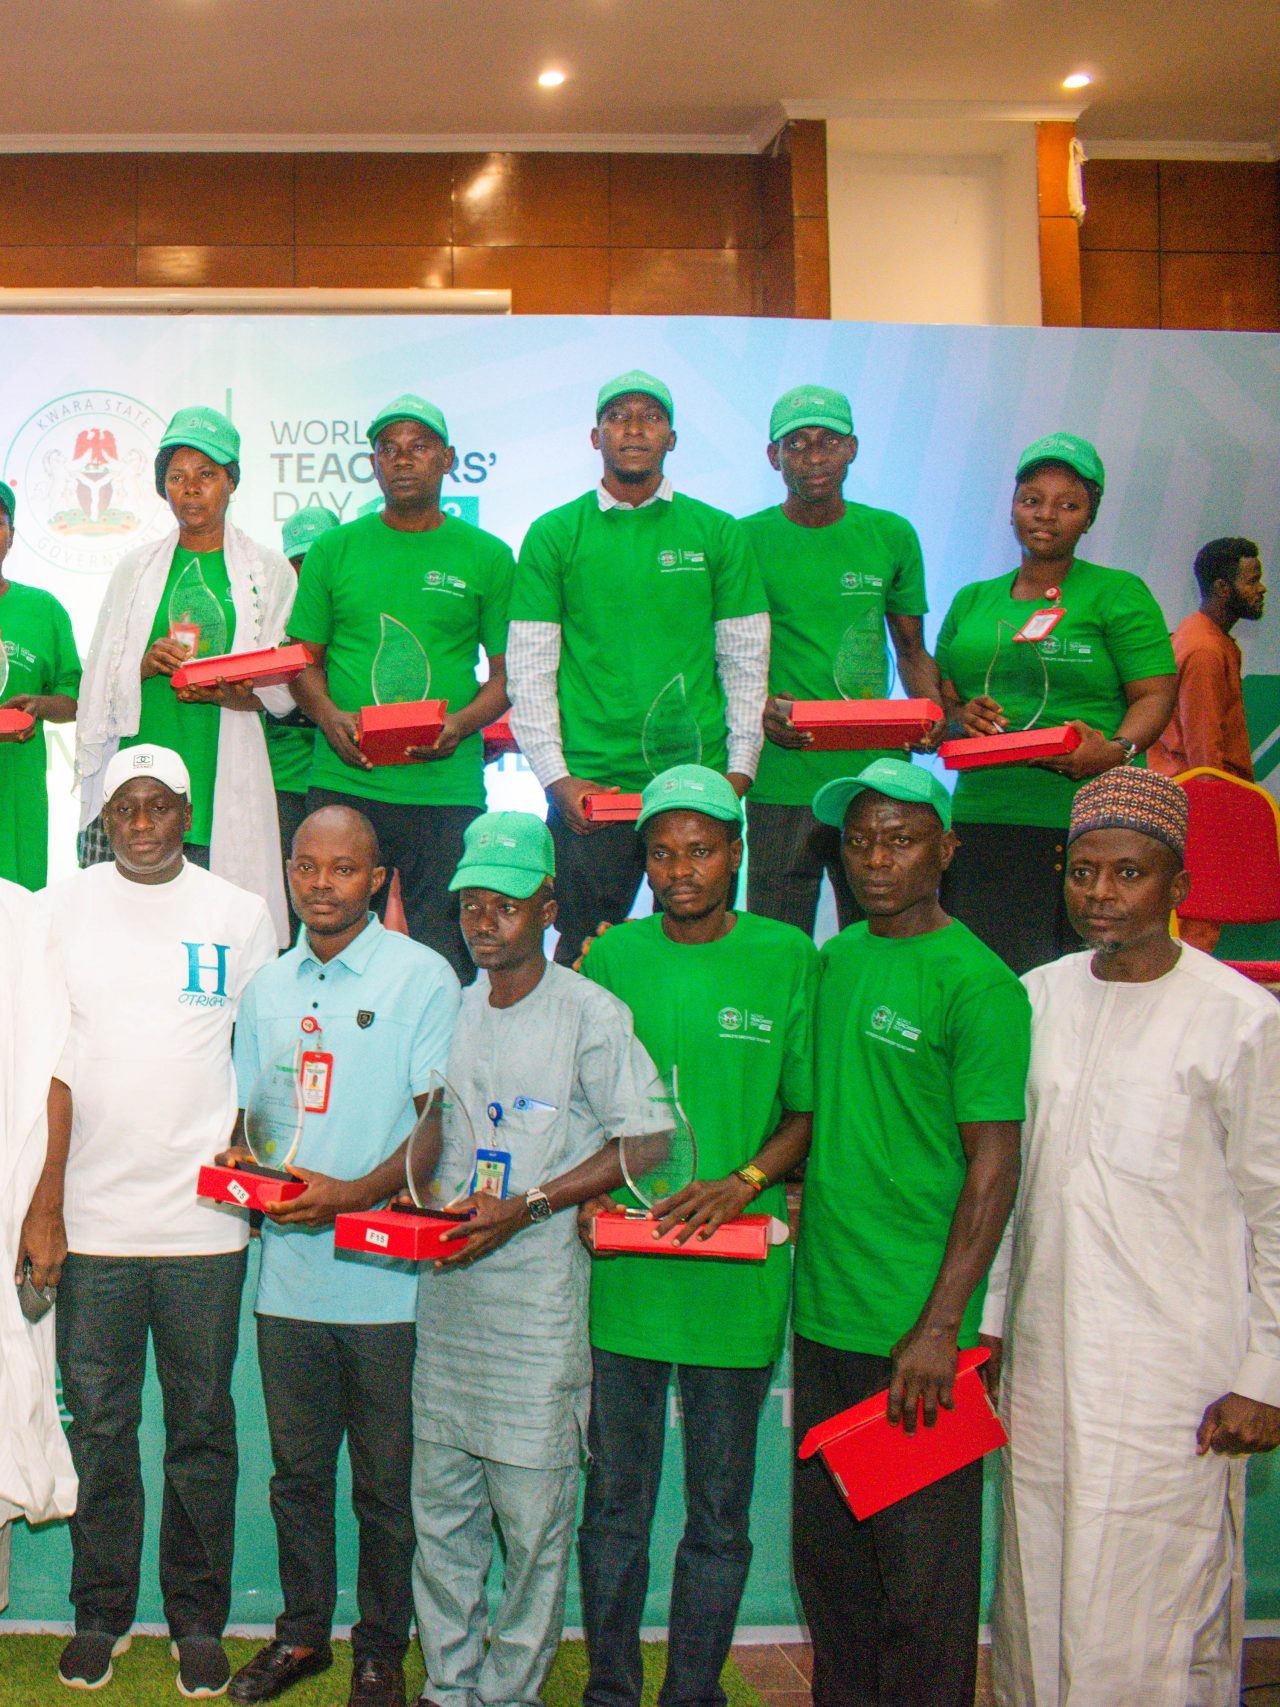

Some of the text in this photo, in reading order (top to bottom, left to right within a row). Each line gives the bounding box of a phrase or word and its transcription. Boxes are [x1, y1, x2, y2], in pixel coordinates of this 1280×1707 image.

[36, 399, 152, 431] KWARA STATE
[270, 420, 374, 445] WORL
[181, 942, 230, 997] H
[232, 1184, 246, 1200] F15
[370, 1231, 385, 1243] F15
